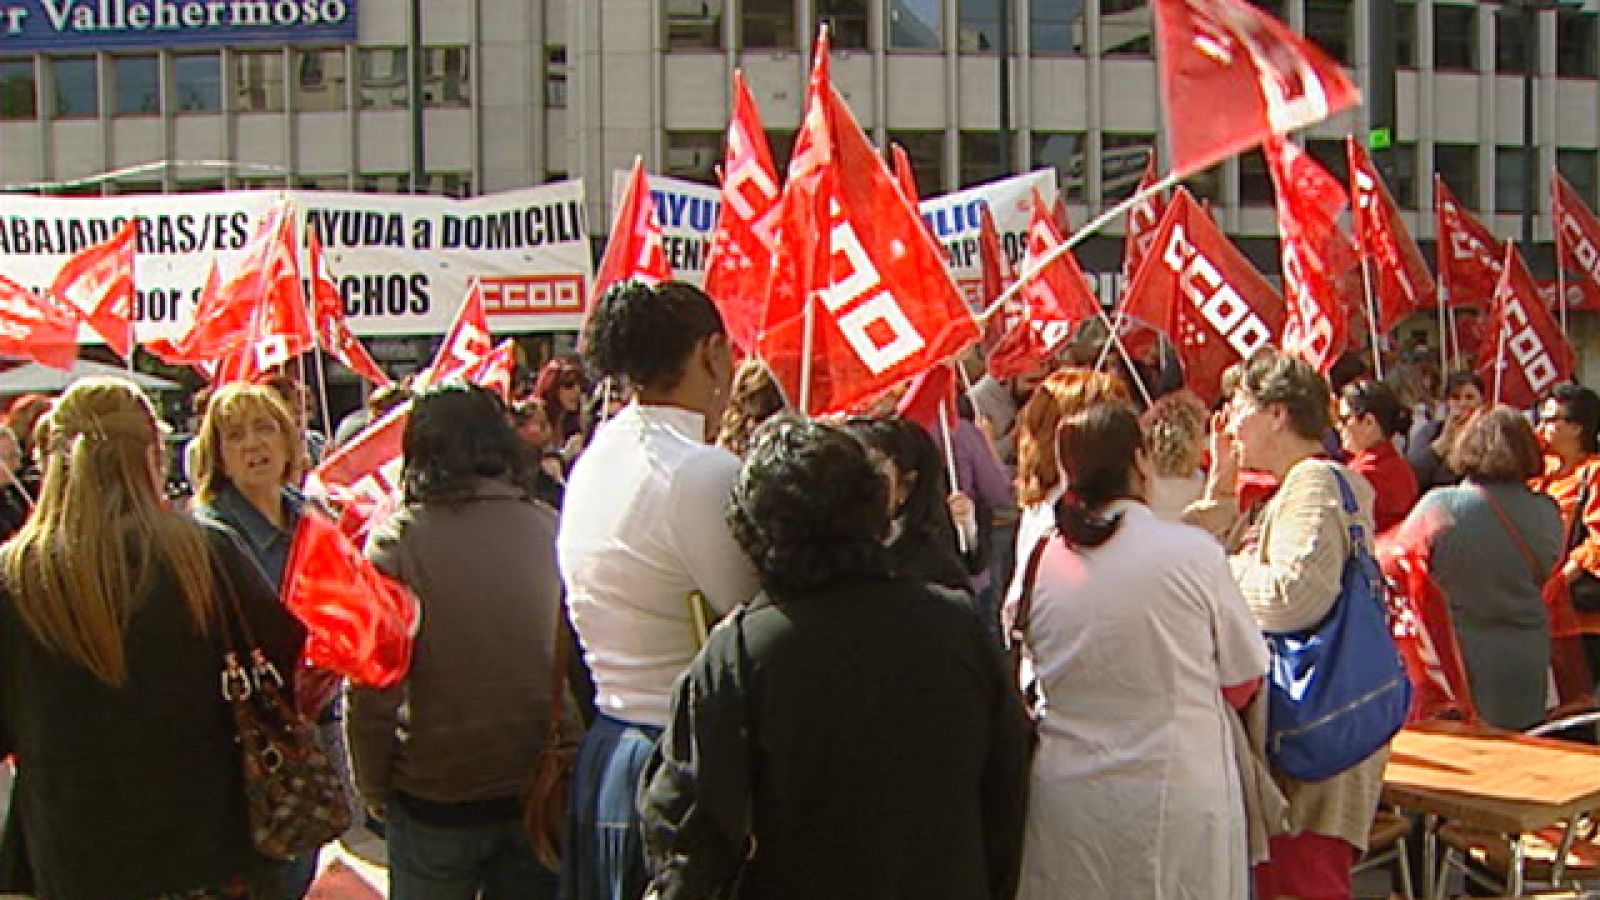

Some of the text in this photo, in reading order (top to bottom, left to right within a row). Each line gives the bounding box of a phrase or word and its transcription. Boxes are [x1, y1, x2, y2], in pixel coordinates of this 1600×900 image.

[41, 0, 346, 31] Vallehermoso
[304, 210, 405, 247] AYUDA
[412, 218, 432, 250] a
[442, 200, 584, 249] DOMICILI
[1164, 224, 1271, 360] CCOO
